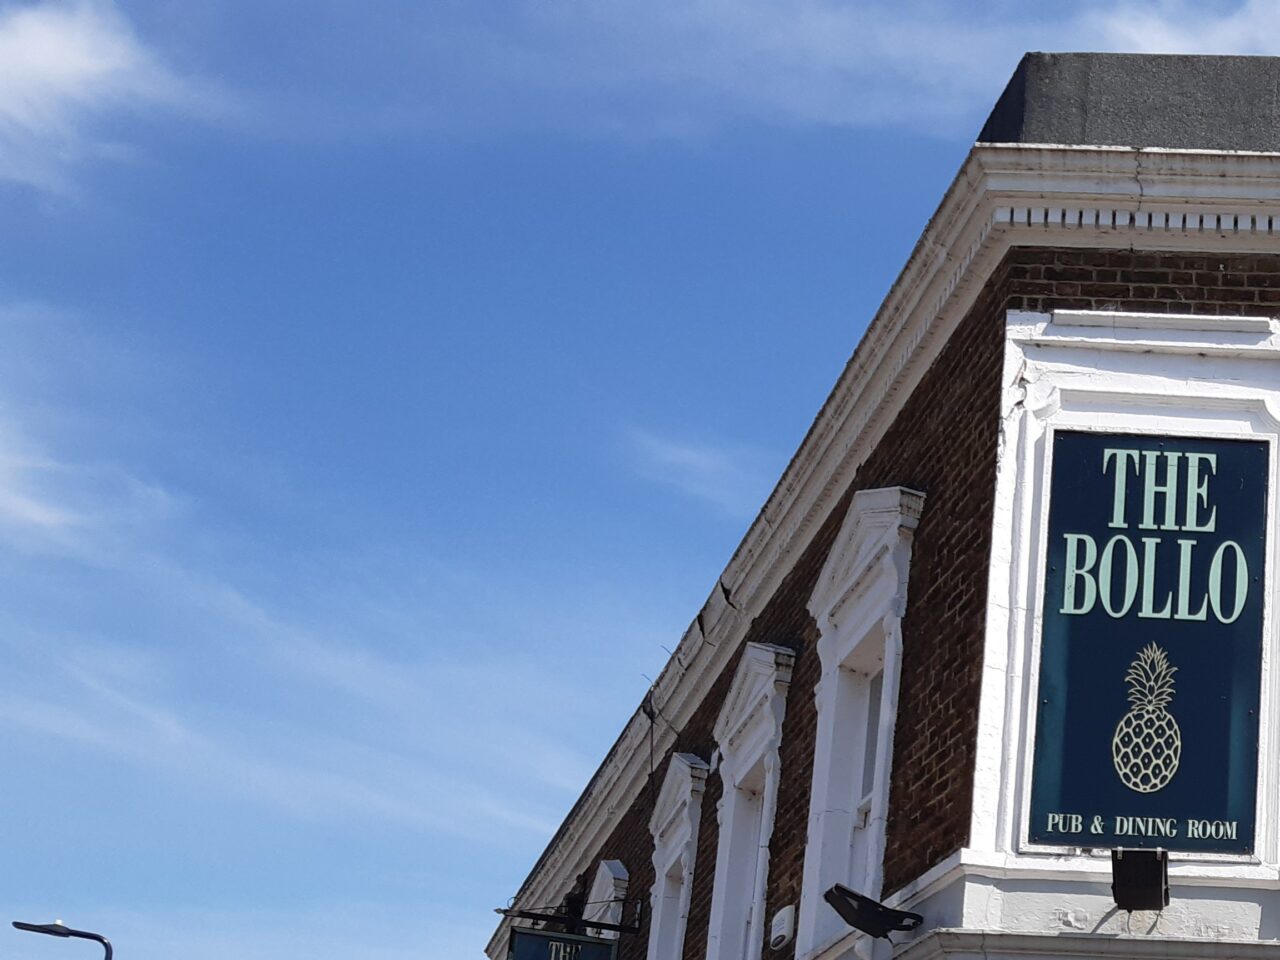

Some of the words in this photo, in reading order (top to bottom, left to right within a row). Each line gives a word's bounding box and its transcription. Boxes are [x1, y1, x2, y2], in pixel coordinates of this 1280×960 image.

[1103, 448, 1217, 533] THE
[1059, 533, 1249, 624] BOLLO
[1046, 813, 1083, 833] PUB
[1090, 814, 1105, 834] &
[1114, 816, 1177, 838] DINING
[1187, 819, 1238, 840] ROOM
